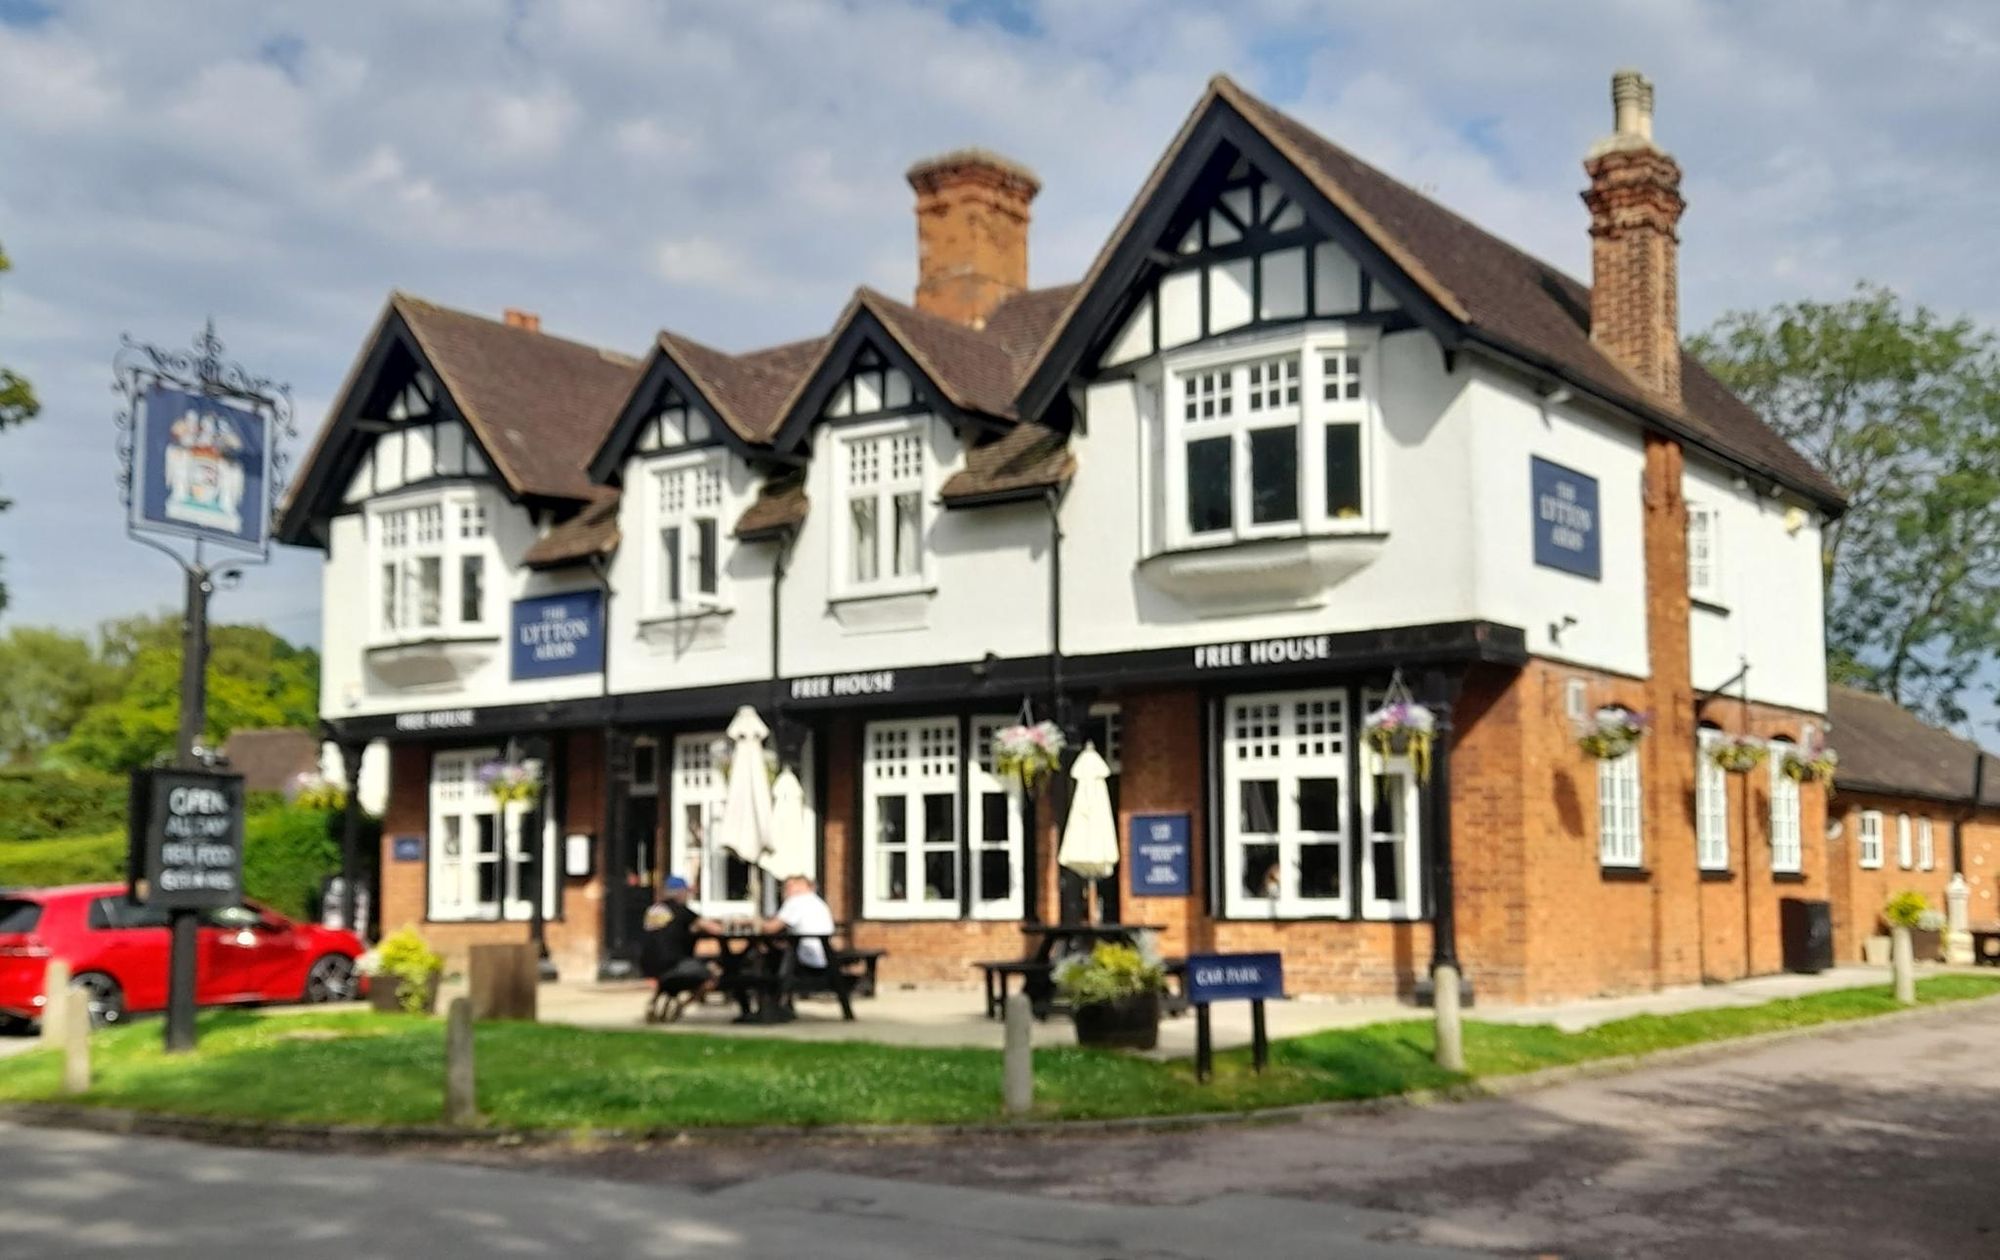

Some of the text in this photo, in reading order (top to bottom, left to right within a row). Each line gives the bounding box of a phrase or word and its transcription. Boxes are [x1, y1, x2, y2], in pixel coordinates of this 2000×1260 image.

[1541, 494, 1592, 532] LYTTON
[542, 605, 567, 620] THE
[520, 618, 589, 646] LYTTON
[535, 640, 576, 660] ARMS
[1195, 636, 1331, 669] FREE HOUSE
[791, 671, 894, 699] FREE HOUSE
[396, 710, 475, 731] FREE HOUSE
[169, 787, 228, 815] OPEN
[164, 816, 230, 837] ALL DAY
[1196, 965, 1262, 986] CAR PARK
